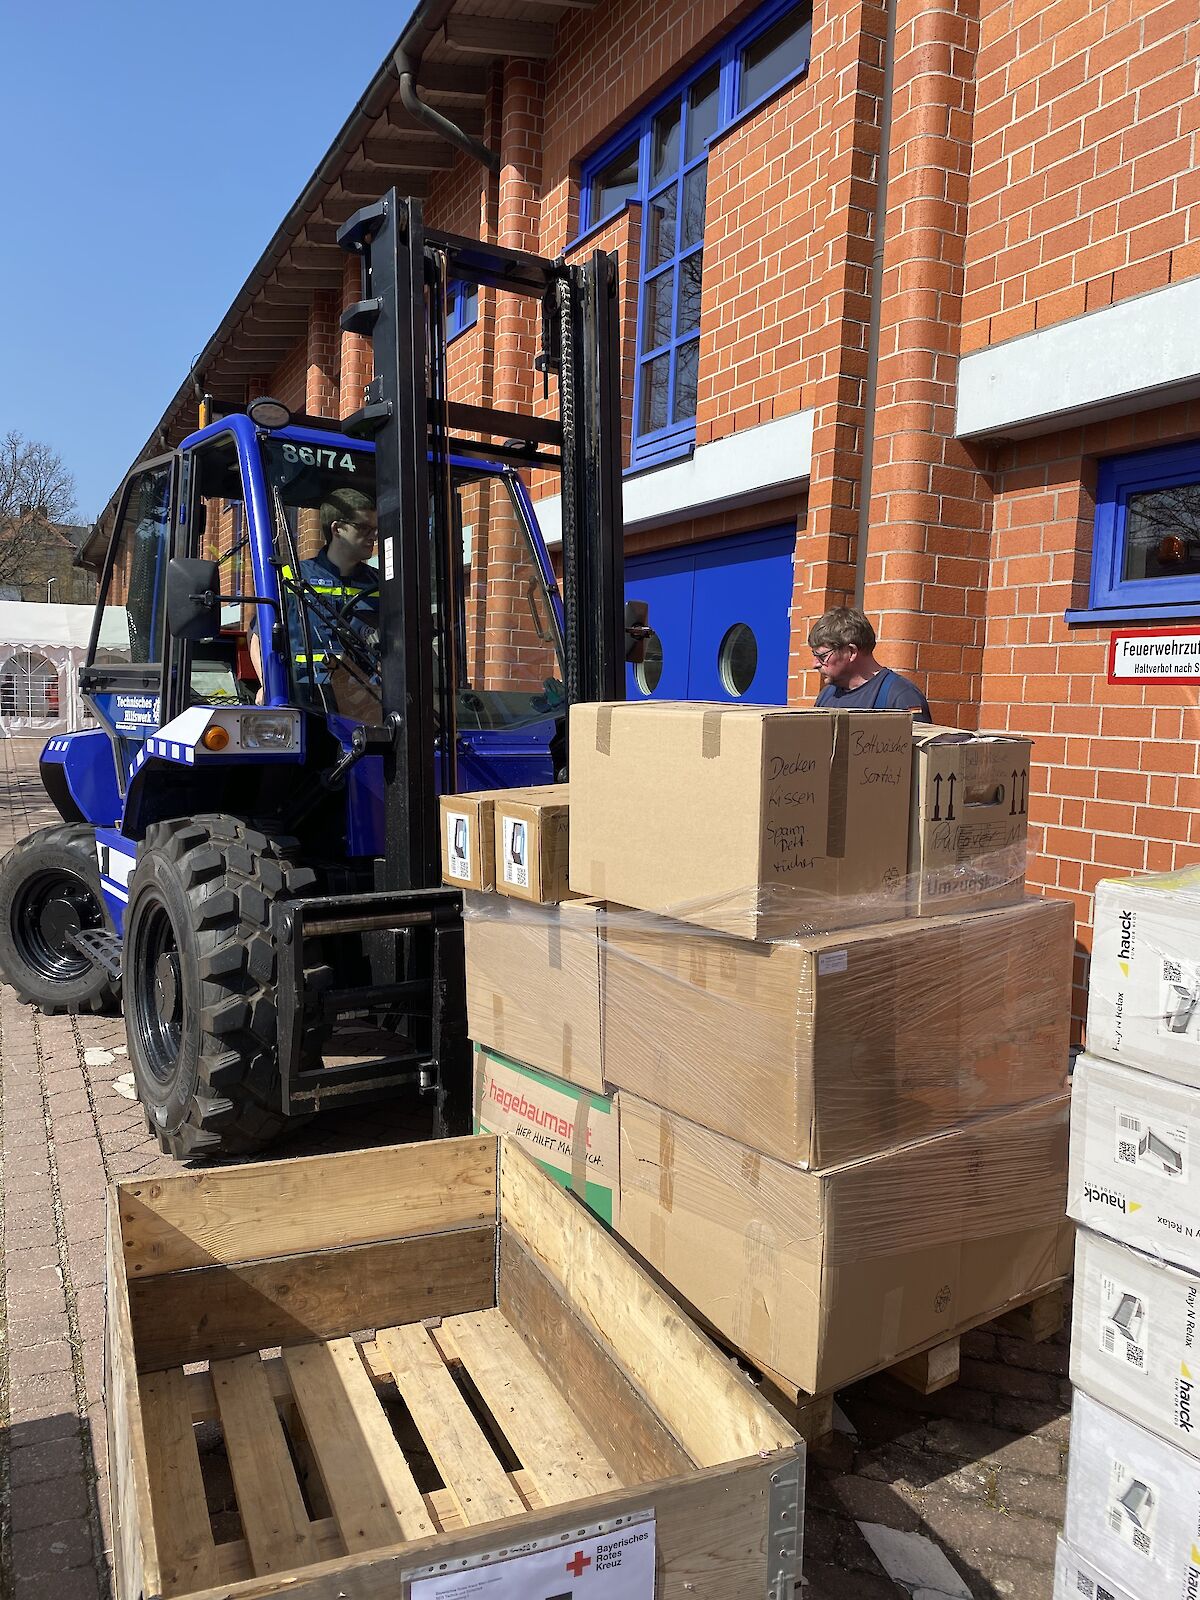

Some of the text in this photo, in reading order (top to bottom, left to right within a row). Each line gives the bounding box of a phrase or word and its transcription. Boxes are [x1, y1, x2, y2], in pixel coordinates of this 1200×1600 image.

[1134, 663, 1172, 674] Haltverbot
[1174, 662, 1193, 673] nach
[116, 695, 152, 709] Technisches
[768, 752, 816, 781] Decken
[768, 784, 816, 808] Kissen
[1117, 909, 1133, 960] hauck
[489, 1078, 592, 1149] hagebaumart
[532, 1133, 557, 1150] HILFT
[557, 1141, 573, 1156] MA
[1084, 1186, 1126, 1214] hauck
[1157, 1215, 1183, 1234] Relax
[1185, 1285, 1197, 1348] Play N Relax
[1179, 1379, 1194, 1433] hauck
[596, 1532, 649, 1554] Bayerisches
[596, 1550, 622, 1563] Rotes
[596, 1559, 622, 1572] Kreuz
